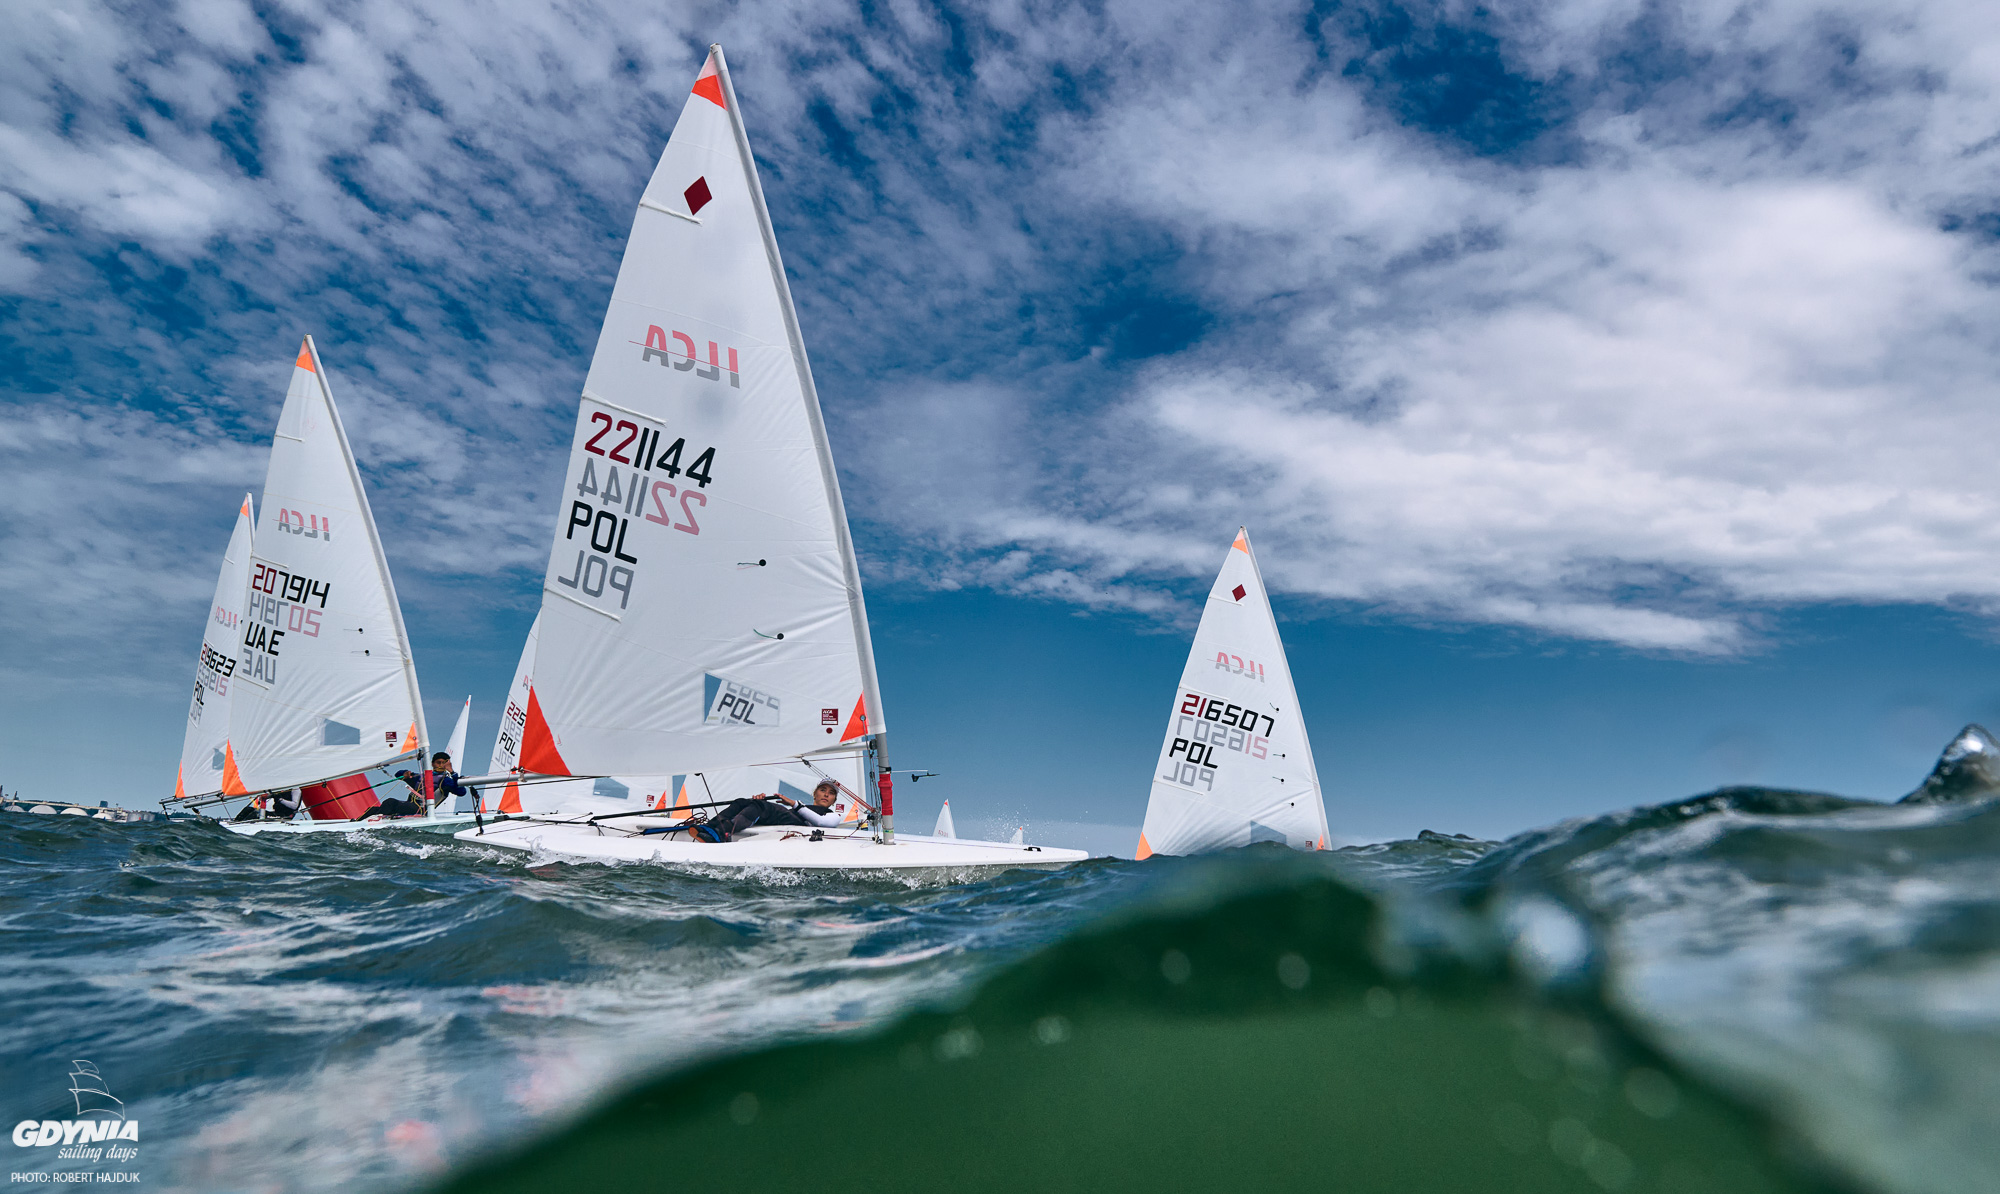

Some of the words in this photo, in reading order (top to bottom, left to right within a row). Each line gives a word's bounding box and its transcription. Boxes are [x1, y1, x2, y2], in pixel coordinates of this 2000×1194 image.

[584, 411, 716, 488] 221144
[566, 500, 637, 565] POL
[252, 563, 331, 608] 207914
[244, 621, 285, 656] UAE
[506, 701, 526, 726] 225
[717, 693, 755, 724] POL
[1180, 693, 1275, 737] 216507
[499, 731, 516, 757] POL
[1168, 737, 1218, 769] POL
